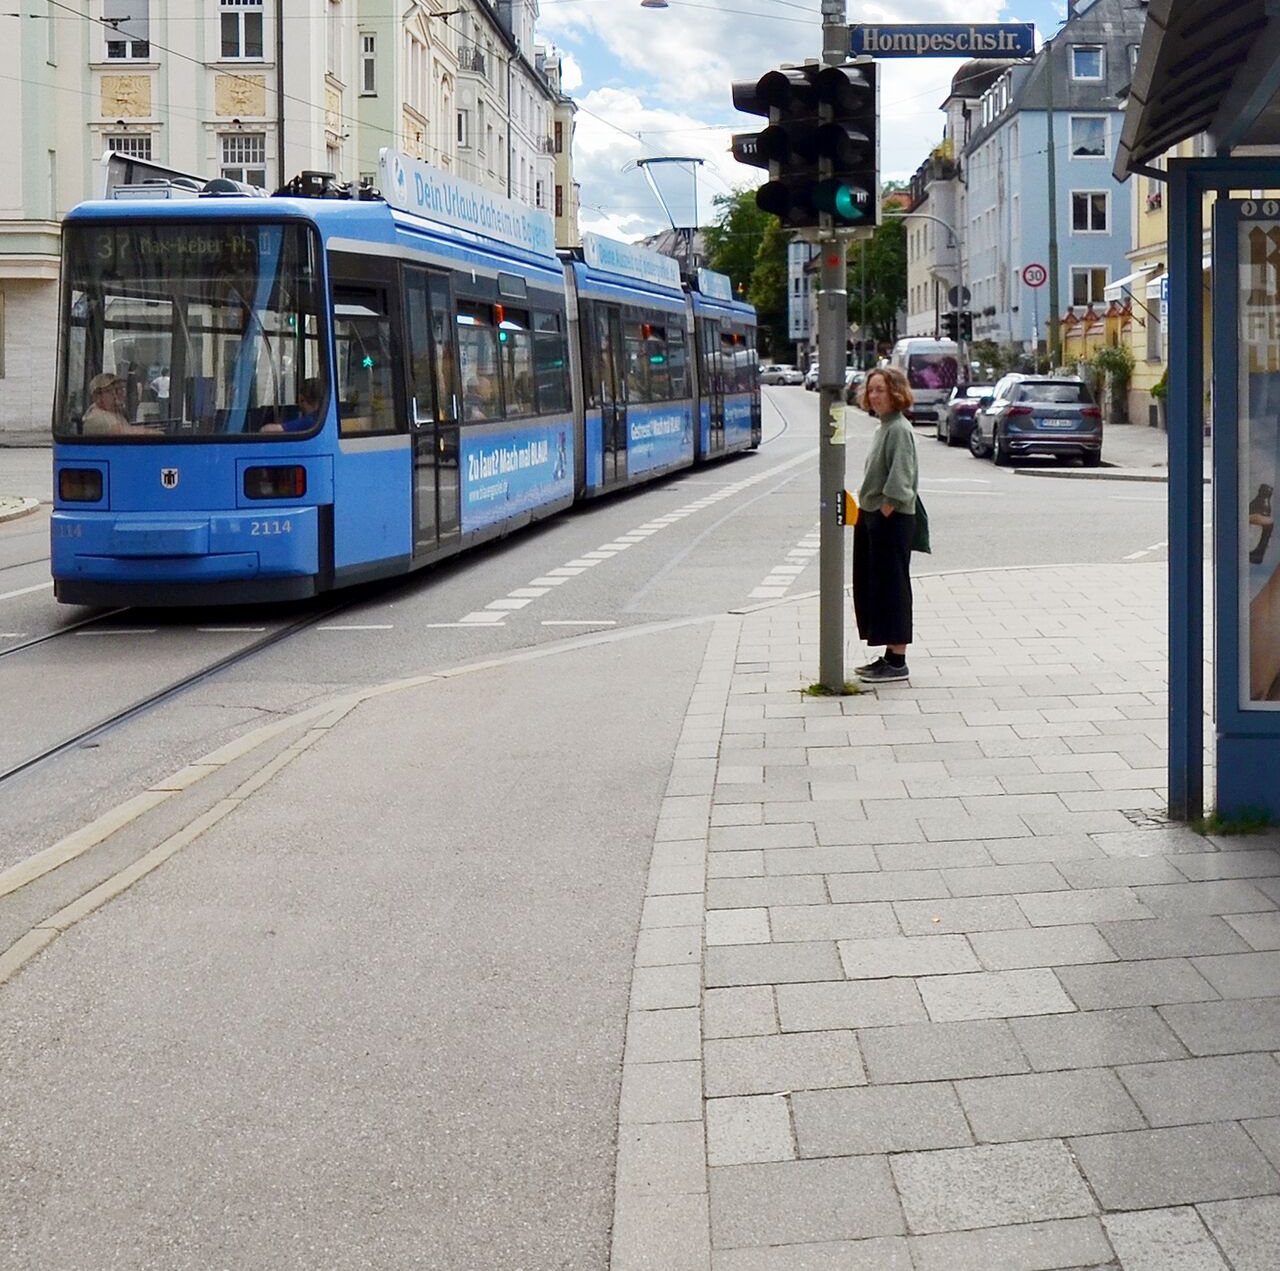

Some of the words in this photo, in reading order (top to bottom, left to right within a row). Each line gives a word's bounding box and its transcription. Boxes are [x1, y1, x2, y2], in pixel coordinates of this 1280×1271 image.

[862, 28, 1022, 54] Hompeschstr.
[415, 172, 443, 213] Dein
[443, 183, 479, 224] Urlaub
[480, 199, 512, 234] daheim
[97, 234, 131, 260] 37
[1028, 269, 1042, 282] 30
[468, 454, 480, 482] Zu
[480, 448, 499, 479] laut?
[500, 444, 519, 473] Mach
[519, 441, 531, 469] mal
[250, 520, 293, 536] 2114
